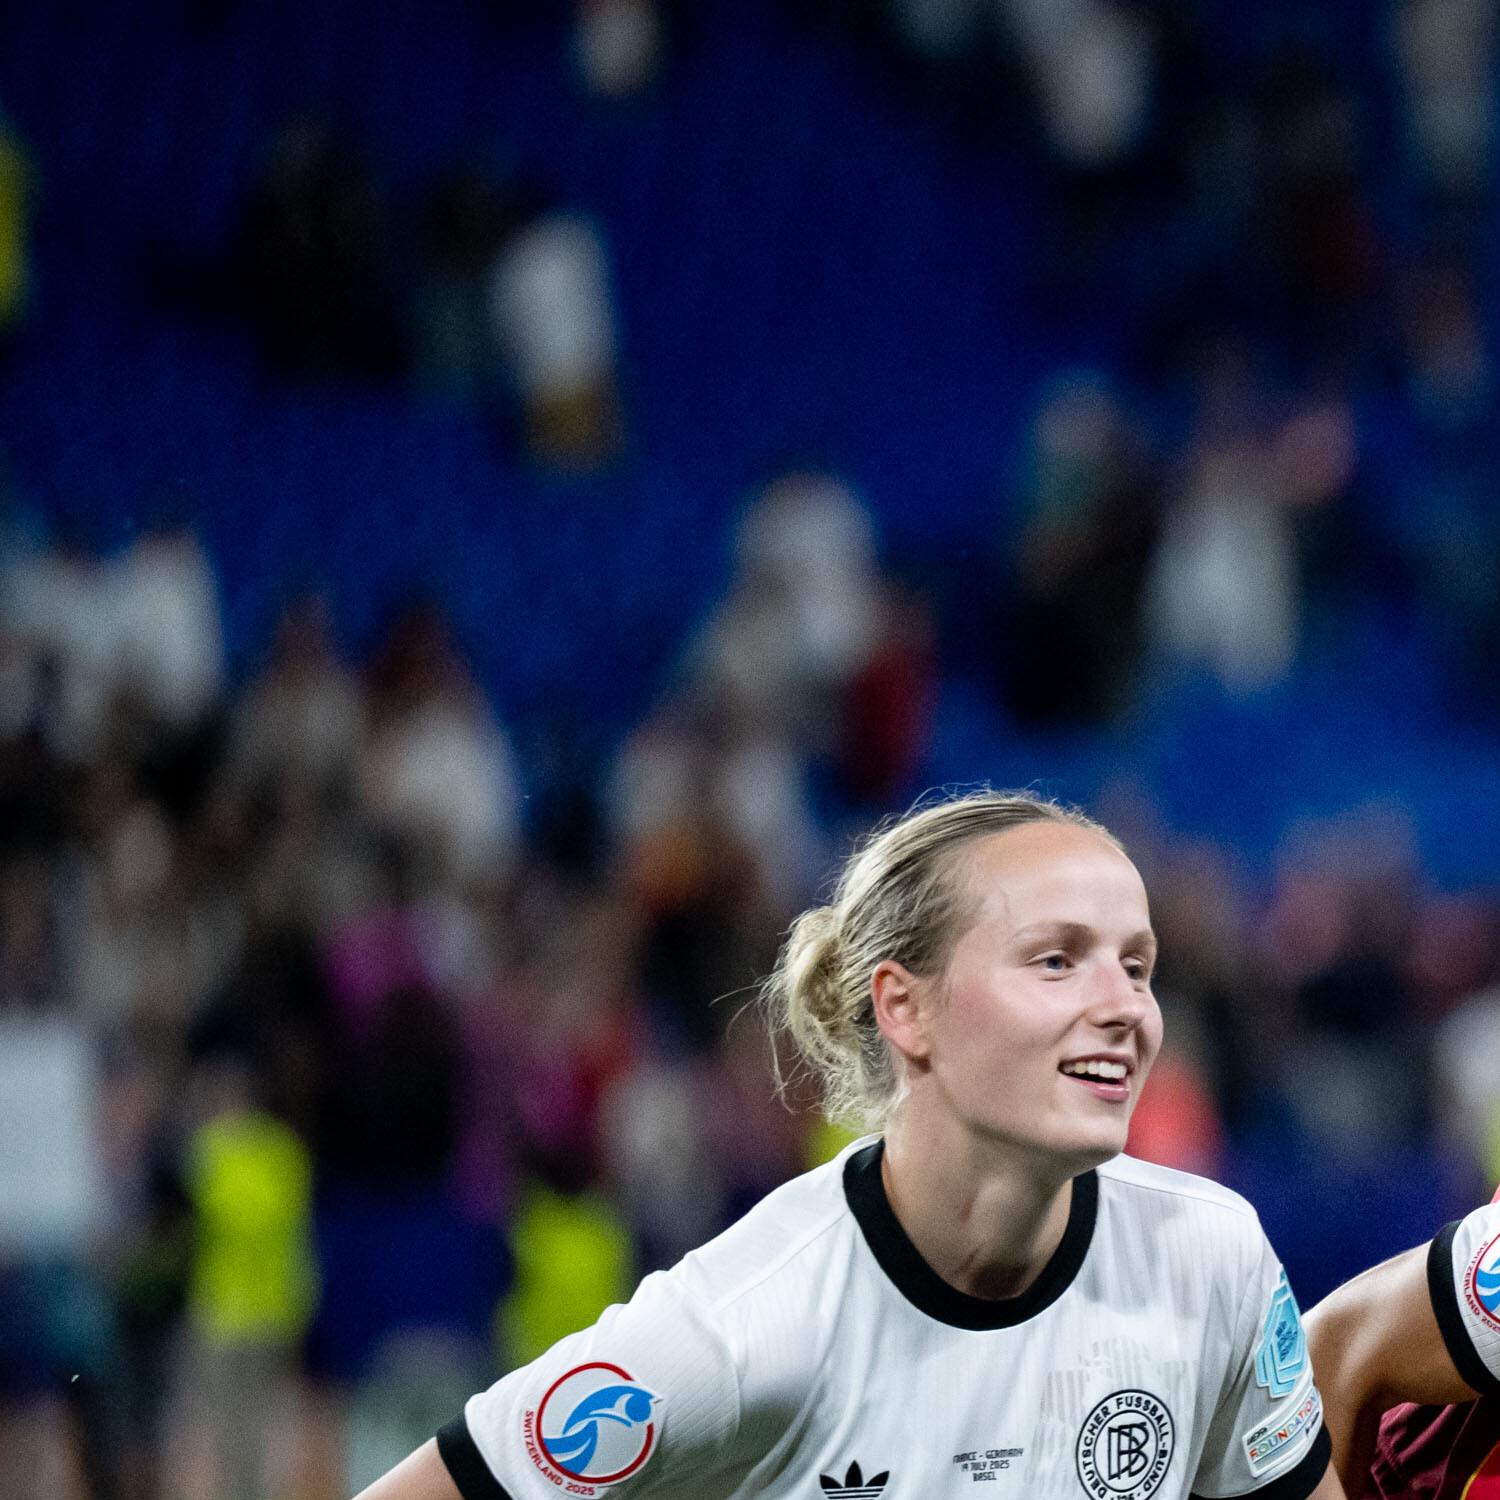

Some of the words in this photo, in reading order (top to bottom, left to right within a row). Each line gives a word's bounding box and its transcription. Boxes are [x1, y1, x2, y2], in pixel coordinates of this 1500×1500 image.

[524, 1410, 563, 1486] SWITZERLAND
[565, 1482, 595, 1496] 2025
[1082, 1405, 1111, 1499] DEUTSCHER
[1115, 1396, 1170, 1492] FUSSBALL-BUND
